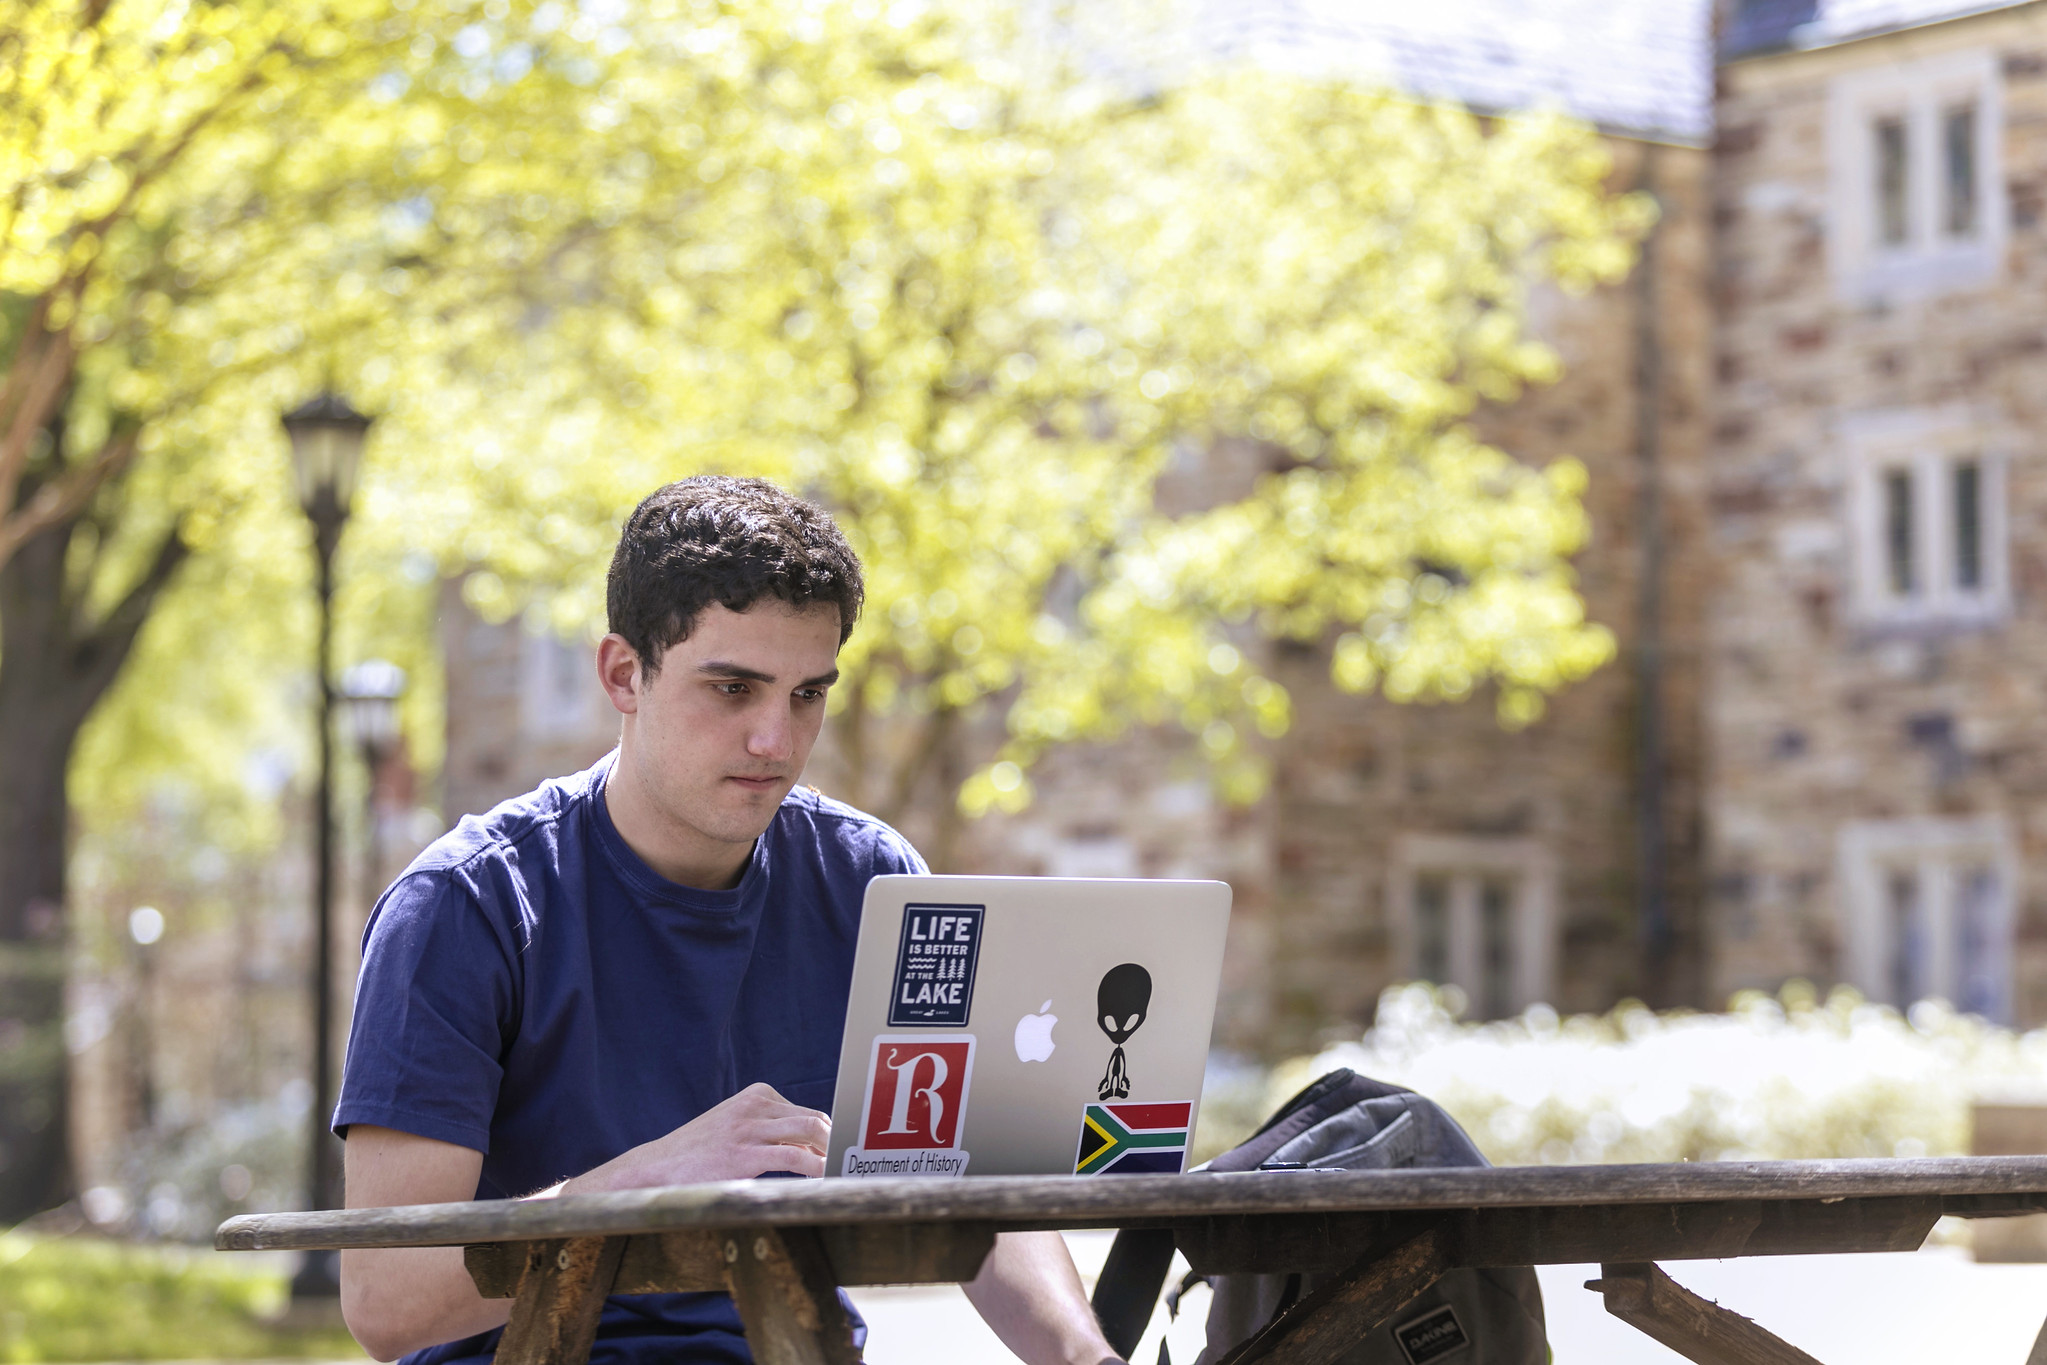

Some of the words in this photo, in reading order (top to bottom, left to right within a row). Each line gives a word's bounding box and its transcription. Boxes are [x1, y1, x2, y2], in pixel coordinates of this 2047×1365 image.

[911, 916, 973, 941] LIFE
[909, 944, 922, 954] IS
[924, 944, 968, 955] BETTER
[917, 972, 934, 980] THE
[901, 982, 964, 1004] LAKE
[877, 1048, 948, 1144] R
[848, 1154, 910, 1178] Department
[912, 1151, 925, 1172] of
[925, 1153, 962, 1177] History
